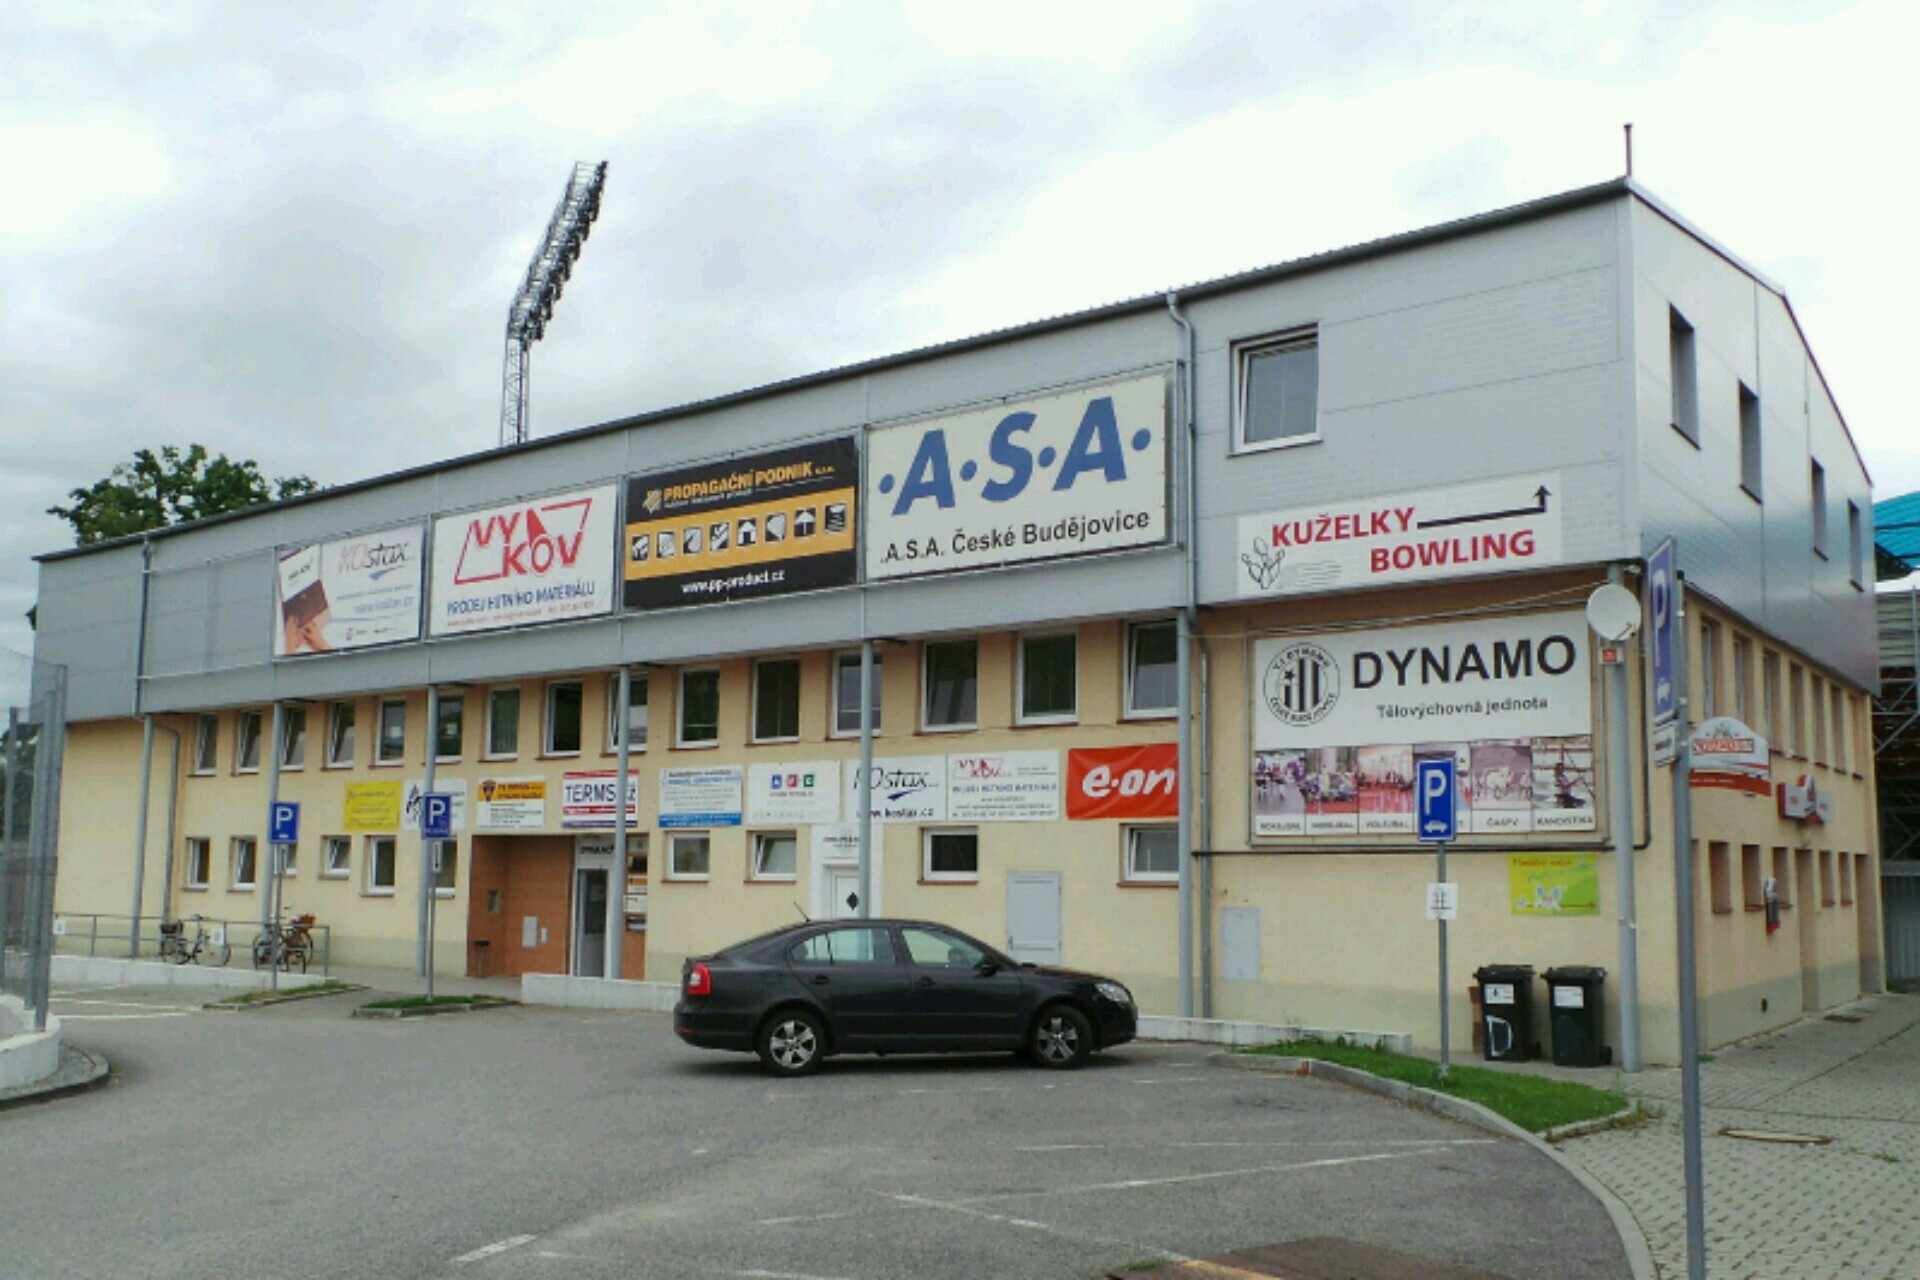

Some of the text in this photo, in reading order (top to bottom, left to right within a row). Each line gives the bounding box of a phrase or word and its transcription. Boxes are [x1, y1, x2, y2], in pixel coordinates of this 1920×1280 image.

[664, 469, 754, 502] PROPAGAČNÍ
[756, 461, 813, 486] PODNIK
[952, 526, 1016, 555] České
[1023, 510, 1150, 545] Budějovice
[1272, 507, 1415, 548] KUŽELKY
[1370, 529, 1536, 574] BOWLING
[682, 570, 785, 594] www.pp-product.cz
[1353, 635, 1576, 689] DYNAMO
[1377, 697, 1549, 720] Tělovýchovná jednota
[429, 799, 447, 826] P
[1424, 769, 1448, 816] P
[276, 806, 294, 831] P
